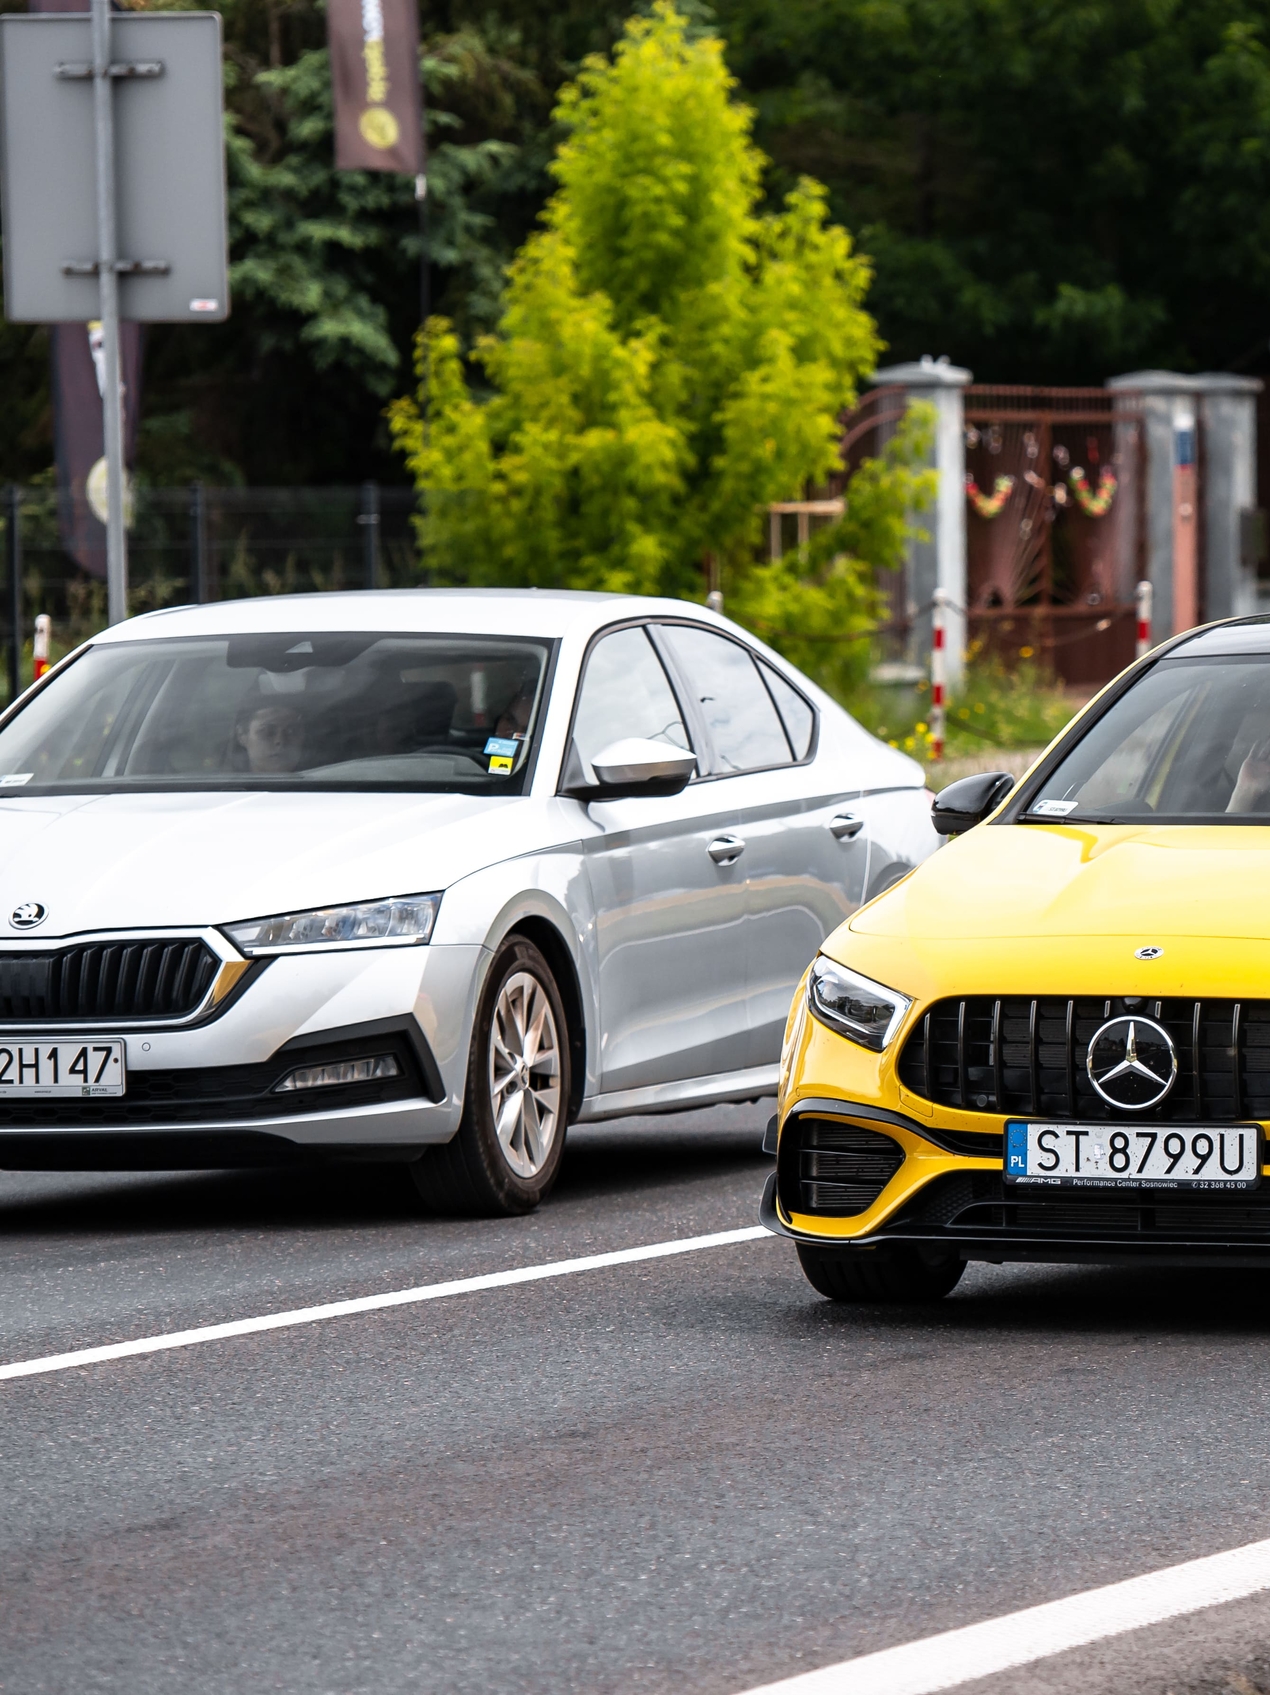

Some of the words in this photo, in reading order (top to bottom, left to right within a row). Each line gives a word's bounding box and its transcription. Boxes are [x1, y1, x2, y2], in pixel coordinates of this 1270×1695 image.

[0, 1046, 112, 1085] 2H147
[1010, 1155, 1025, 1168] PL
[1037, 1130, 1089, 1172] ST
[1108, 1131, 1244, 1176] 8799U
[1073, 1178, 1115, 1187] Performance
[1116, 1180, 1140, 1188] Center
[1141, 1180, 1178, 1188] Sosnowiec
[1199, 1181, 1209, 1189] 32
[1210, 1181, 1224, 1189] 368
